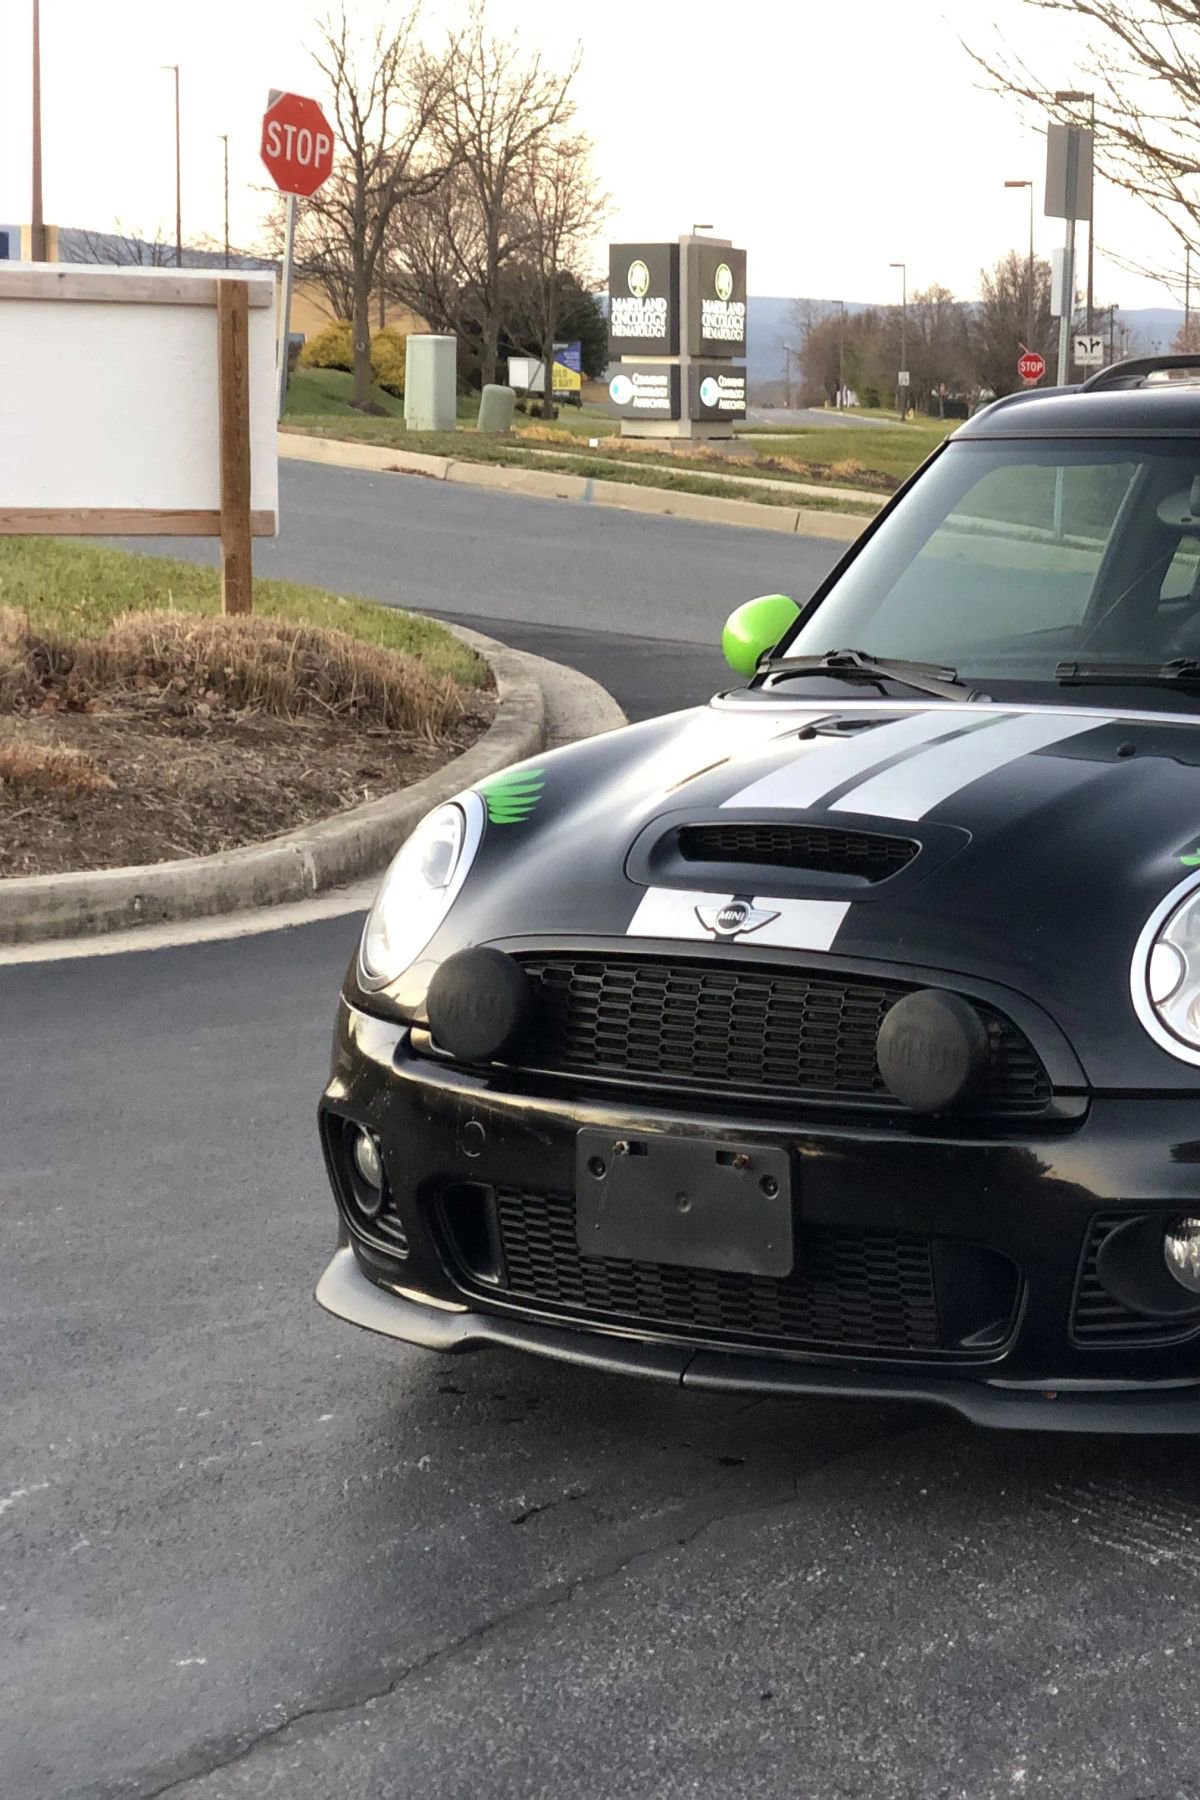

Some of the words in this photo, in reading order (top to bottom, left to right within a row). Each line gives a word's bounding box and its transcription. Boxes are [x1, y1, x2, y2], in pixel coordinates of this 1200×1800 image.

[265, 120, 330, 168] STOP
[611, 298, 667, 313] MARYLAND
[702, 300, 745, 316] MARYLAND
[611, 311, 667, 326] ONCOLOGY
[702, 313, 744, 330] ONCOLOGY
[611, 324, 666, 338] HEMATOLOGY
[702, 327, 744, 341] HEMATOLOGY
[1020, 361, 1043, 373] STOP
[718, 910, 746, 921] MINI
